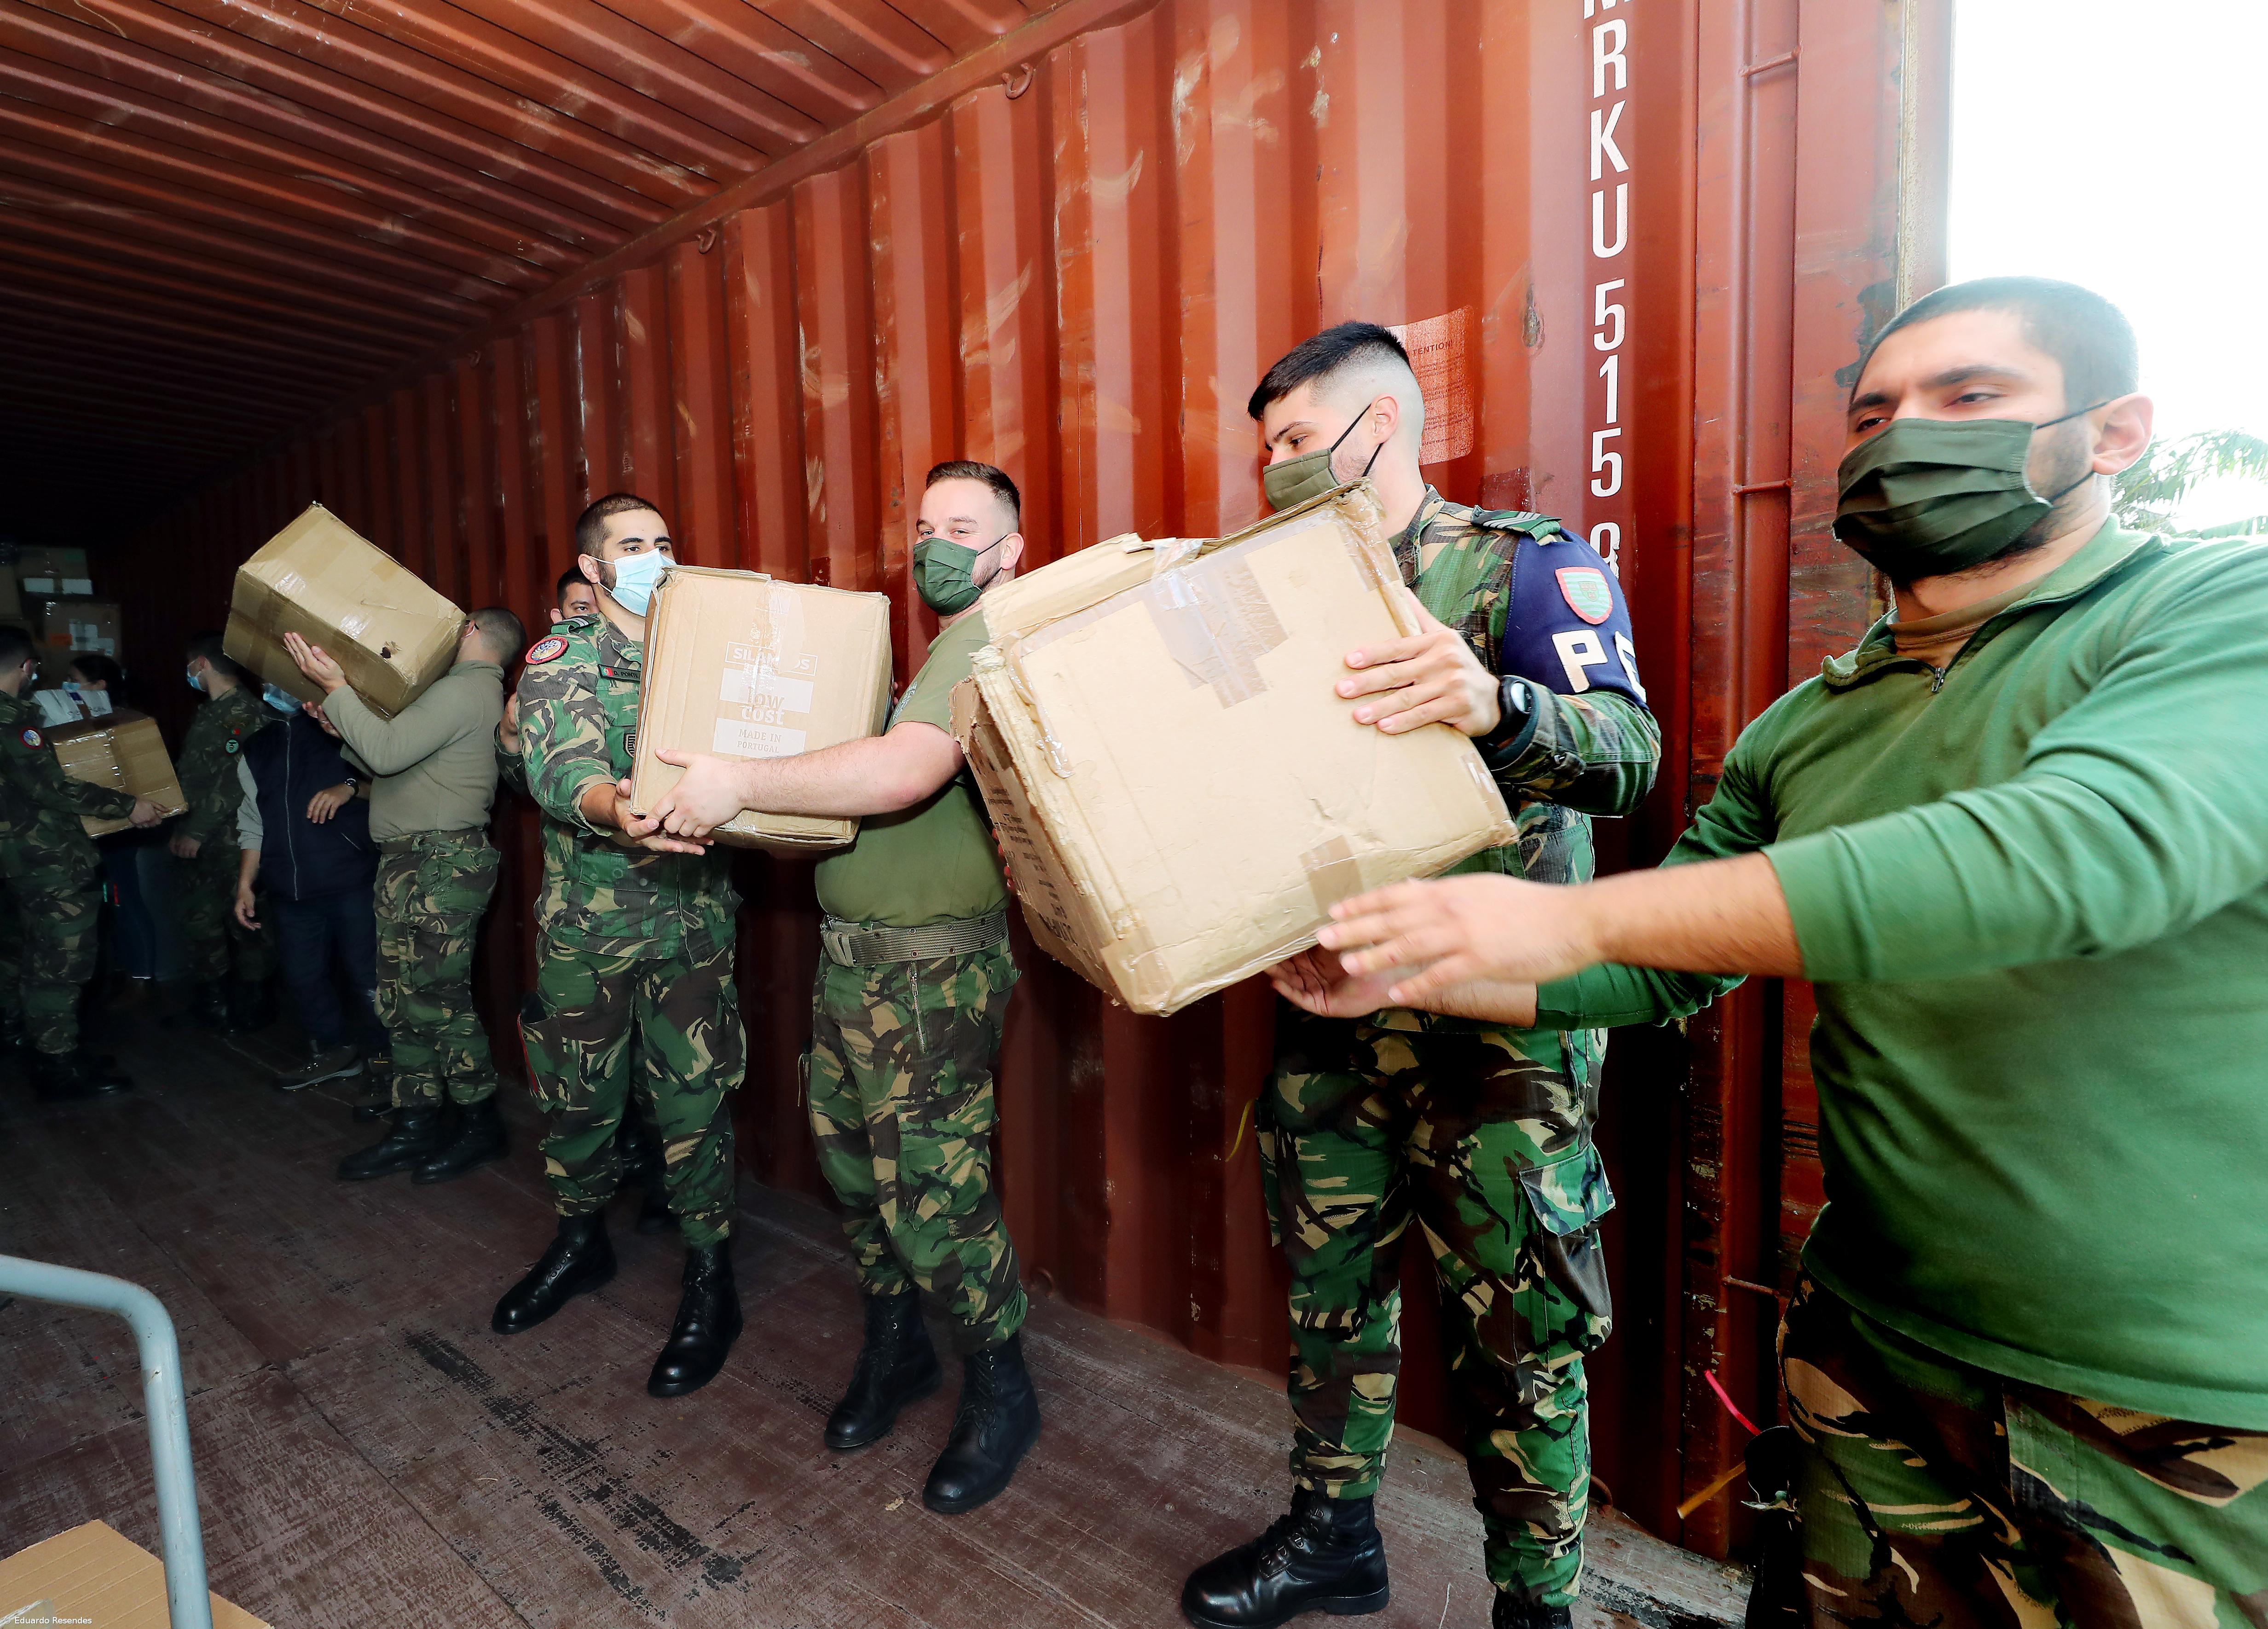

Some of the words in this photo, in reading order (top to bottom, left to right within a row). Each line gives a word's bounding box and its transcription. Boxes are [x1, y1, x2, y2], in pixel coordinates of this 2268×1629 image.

[1583, 0, 1633, 259] RKU
[1408, 339, 1453, 356] TENTION!
[738, 728, 767, 741] MADE
[770, 733, 782, 743] IN
[737, 740, 780, 753] PORTUGAL
